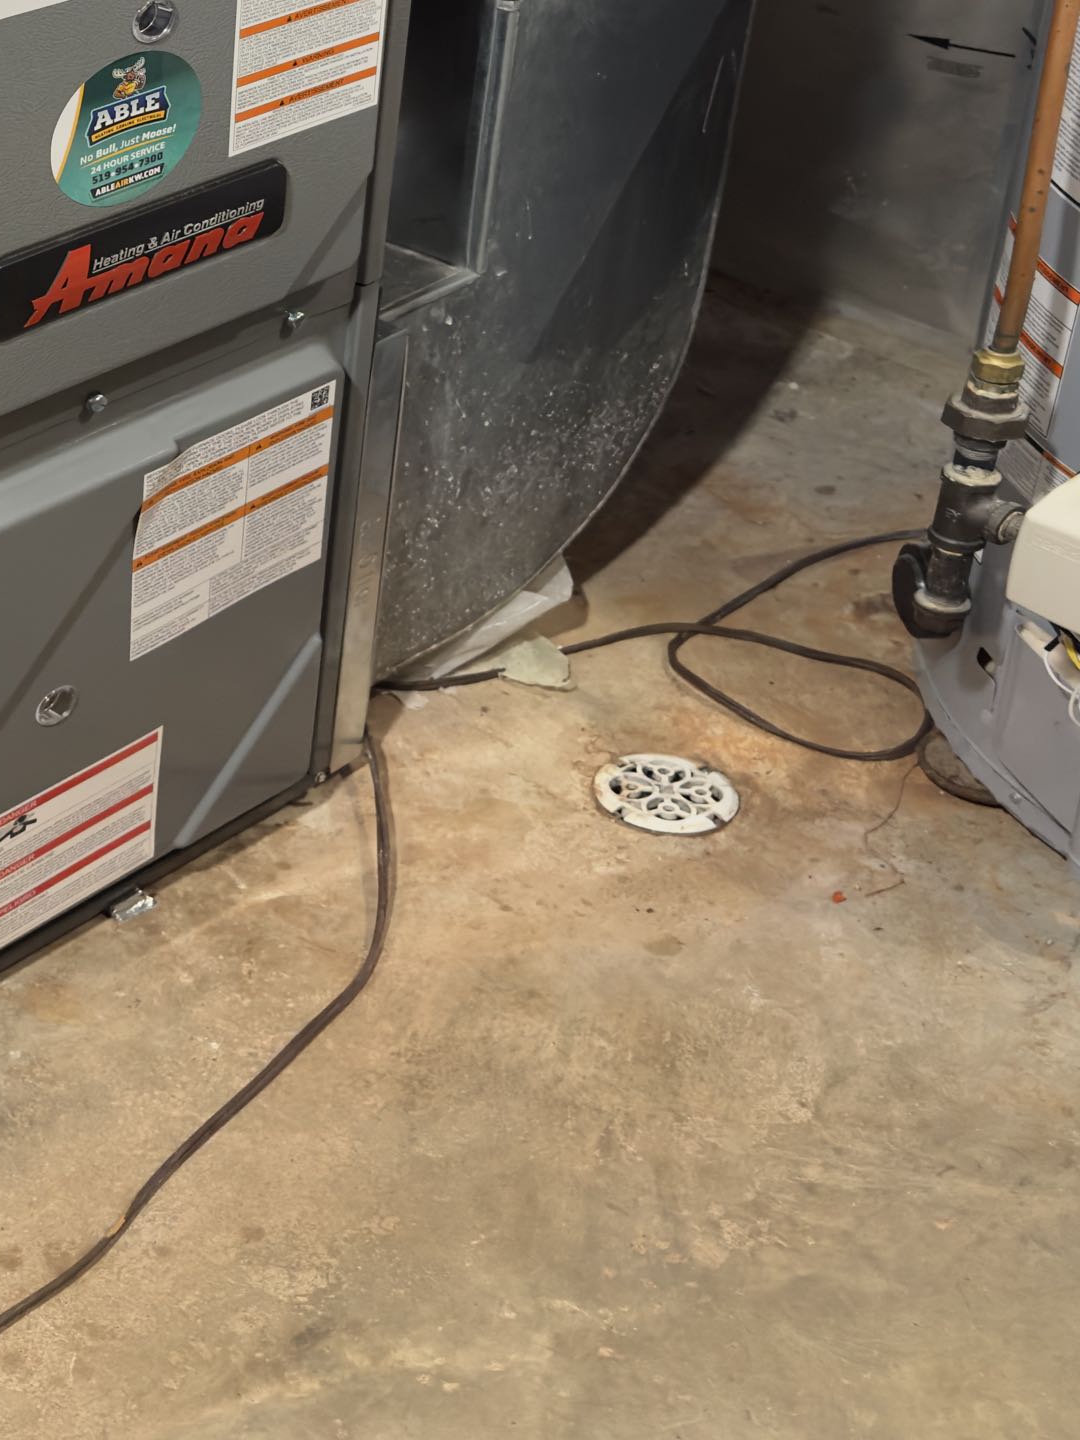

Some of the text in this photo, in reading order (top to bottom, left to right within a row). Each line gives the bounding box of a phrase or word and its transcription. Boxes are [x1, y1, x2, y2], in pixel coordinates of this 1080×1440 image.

[302, 48, 334, 64] WARNING
[289, 78, 344, 104] AVERTISSEMENT
[94, 92, 160, 130] ABLE
[80, 124, 176, 166] No Bull, Just Moose!
[90, 142, 166, 174] 24 HOUR SERVICE
[94, 165, 161, 197] ABLEAIRKW.COM
[92, 198, 265, 271] Heating & Air Conditioning
[24, 211, 264, 328] Amana
